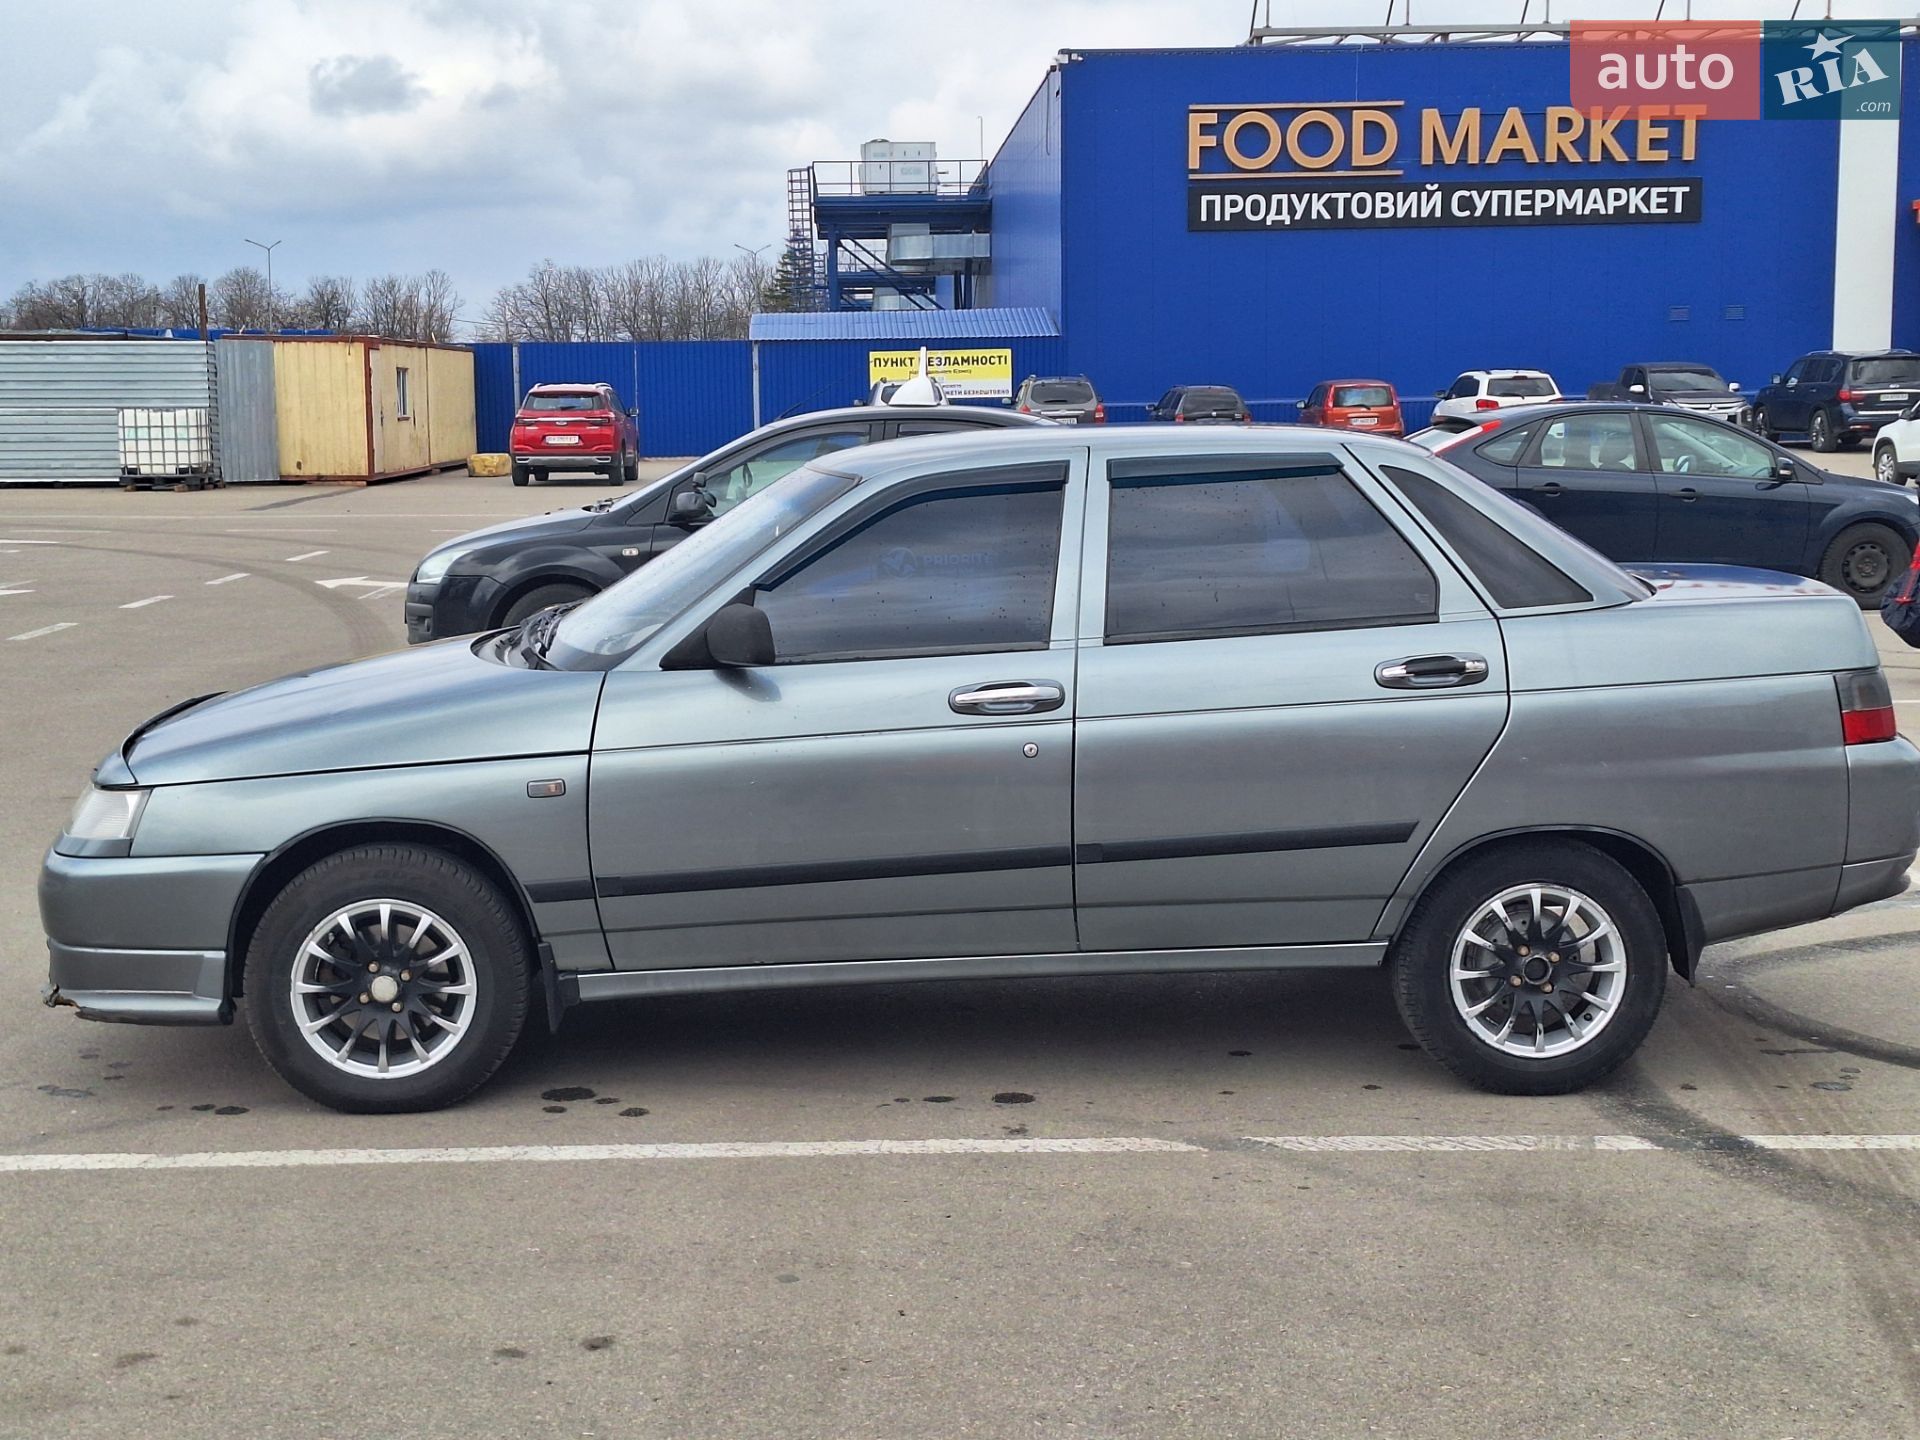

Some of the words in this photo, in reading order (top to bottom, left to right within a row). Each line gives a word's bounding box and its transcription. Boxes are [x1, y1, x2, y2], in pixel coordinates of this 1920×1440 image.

[1188, 109, 1399, 170] FOOD
[1420, 104, 1707, 165] MARKET
[1200, 183, 1442, 225] ПРОДУКТОВИЙ
[1450, 186, 1690, 217] СУПЕРМАРКЕТ
[873, 357, 915, 367] ПУНКТ
[919, 355, 1007, 367] ЕЗЛАМНОСТІ
